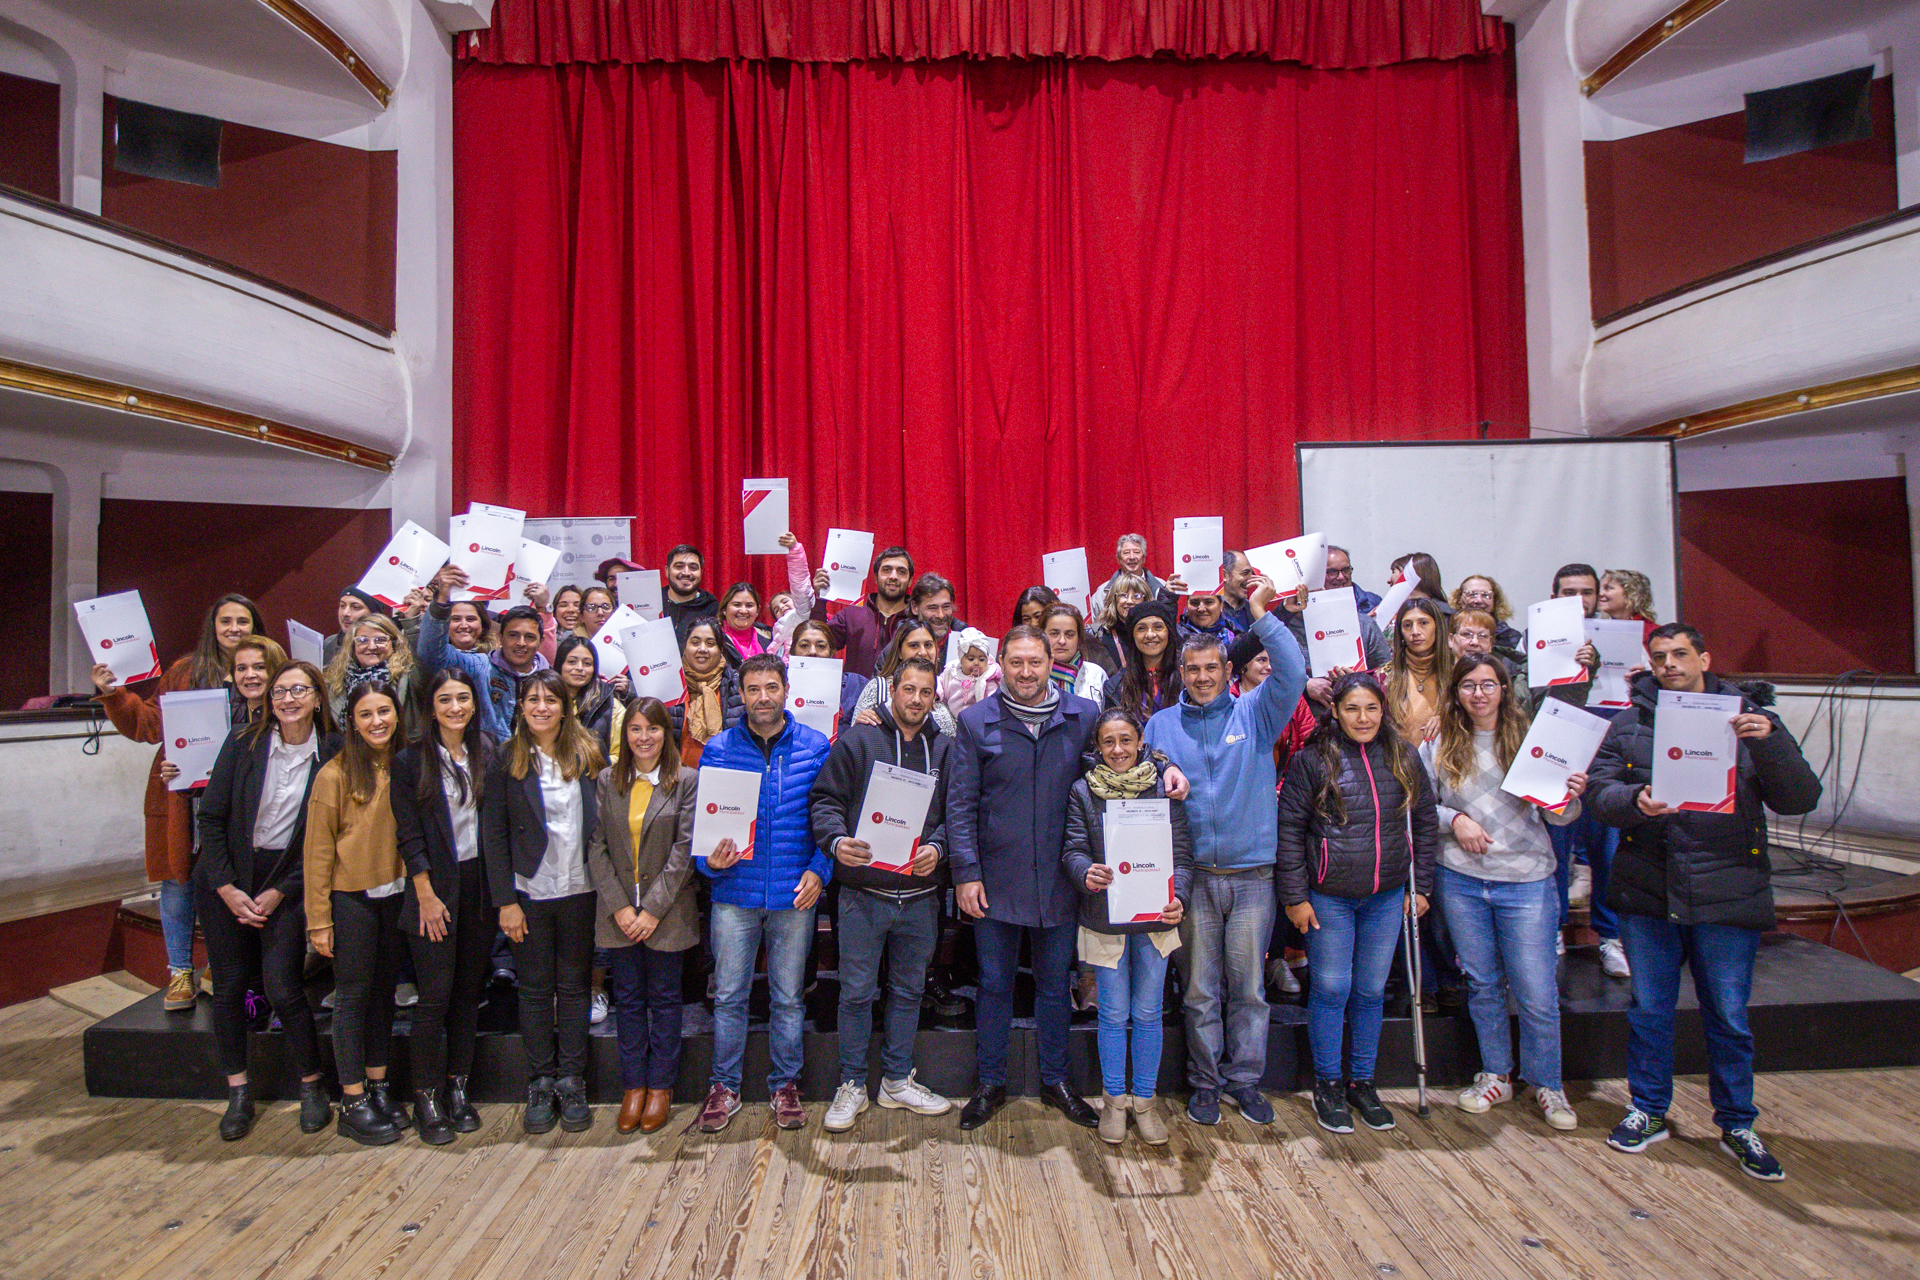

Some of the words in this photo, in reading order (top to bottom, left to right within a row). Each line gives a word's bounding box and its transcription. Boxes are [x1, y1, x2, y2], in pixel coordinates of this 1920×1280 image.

[481, 545, 500, 553] Lincoln
[1293, 558, 1303, 576] Lincoln
[516, 574, 531, 582] Lincoln
[112, 634, 134, 642] Lincoln
[649, 660, 667, 669] Lincoln
[1544, 751, 1567, 764] Lincoln
[884, 815, 906, 825] Lincoln
